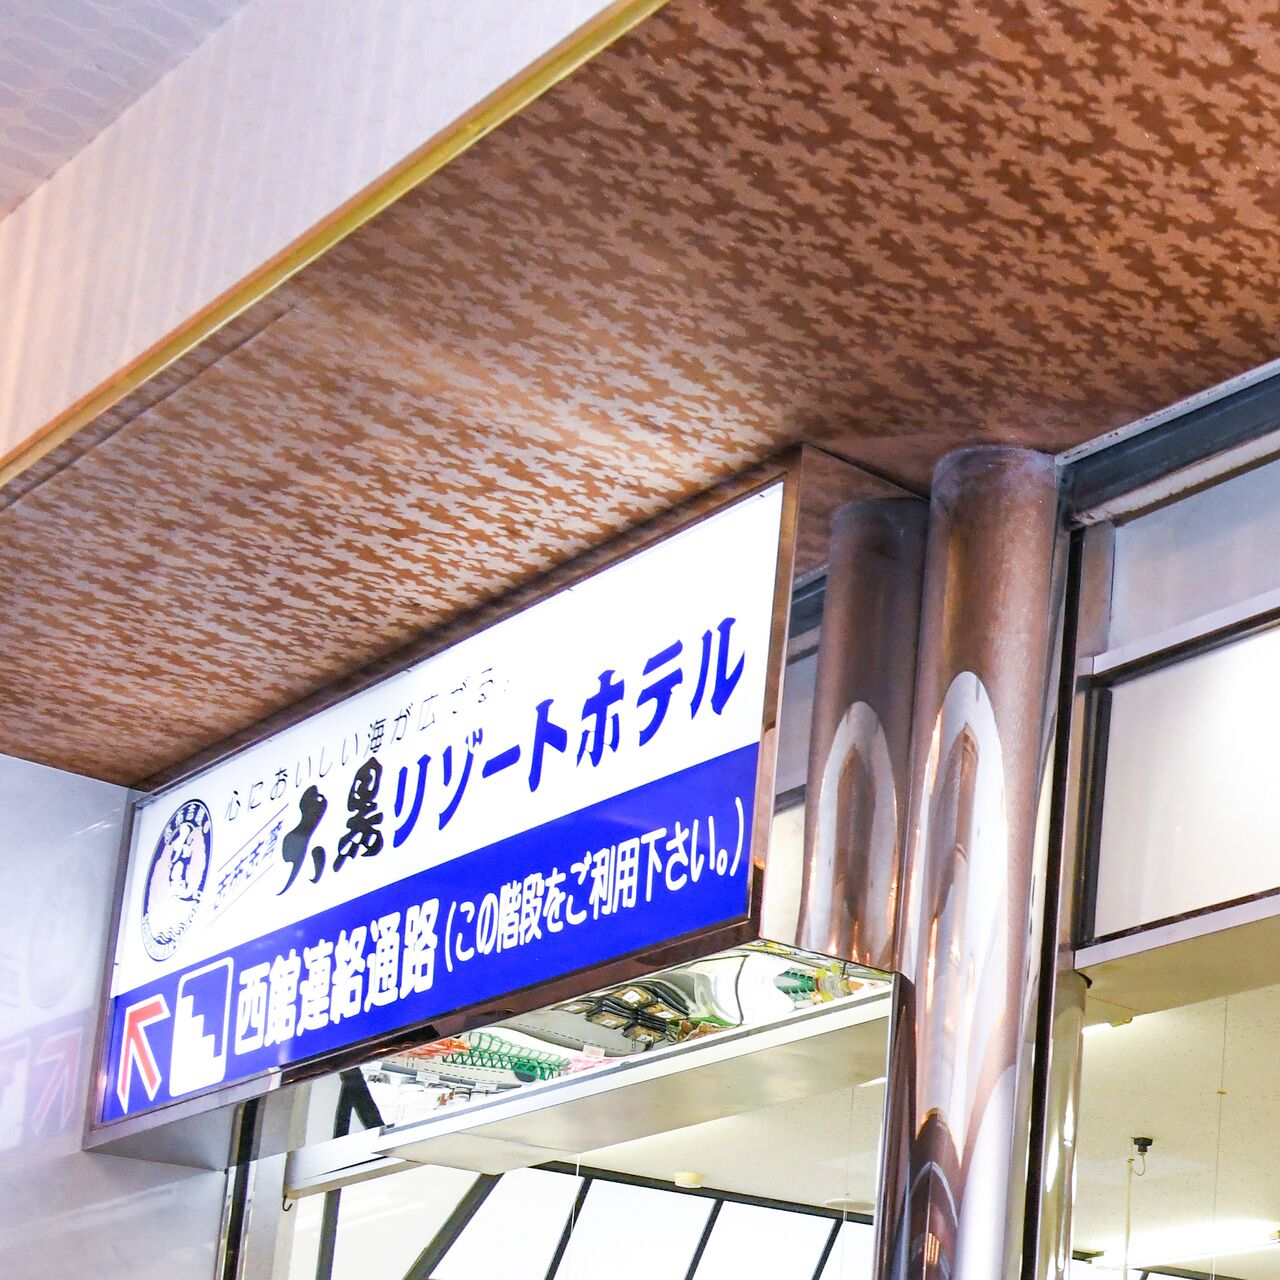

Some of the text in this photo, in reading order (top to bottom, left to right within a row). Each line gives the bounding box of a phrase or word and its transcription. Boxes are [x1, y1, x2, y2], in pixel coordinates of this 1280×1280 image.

[236, 795, 745, 1058] 西館連絡通路 (この階段をご利用下さい。)
